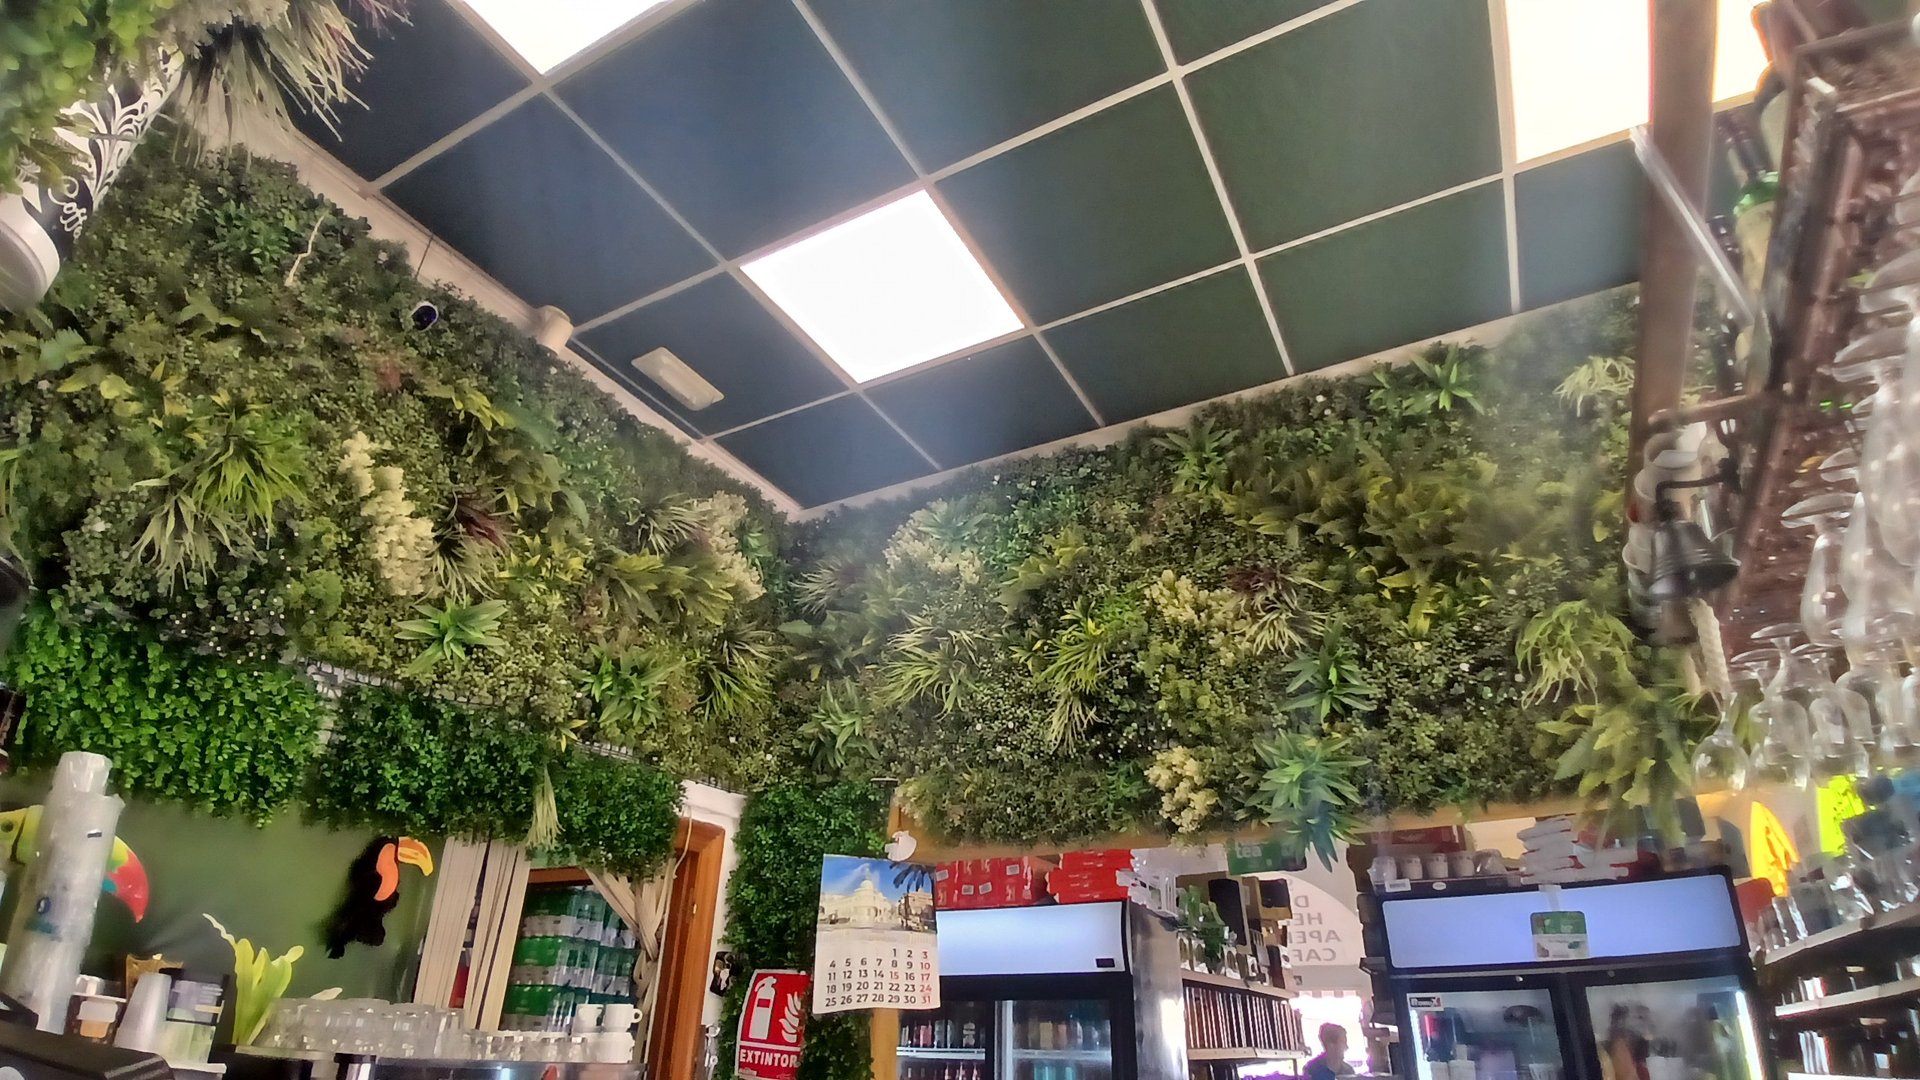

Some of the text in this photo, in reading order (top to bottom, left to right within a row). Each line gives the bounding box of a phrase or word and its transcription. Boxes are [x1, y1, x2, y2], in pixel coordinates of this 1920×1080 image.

[893, 949, 928, 959] 1 2 3
[829, 957, 930, 970] 4 5 6 7 8 9 10
[828, 969, 930, 981] 11 12 13 14 15 16 17
[826, 981, 932, 994] 18 19 20 21 22 23 24
[825, 993, 931, 1007] 25 26 27 28 29 30 31
[740, 1049, 800, 1068] EXTINTOR
